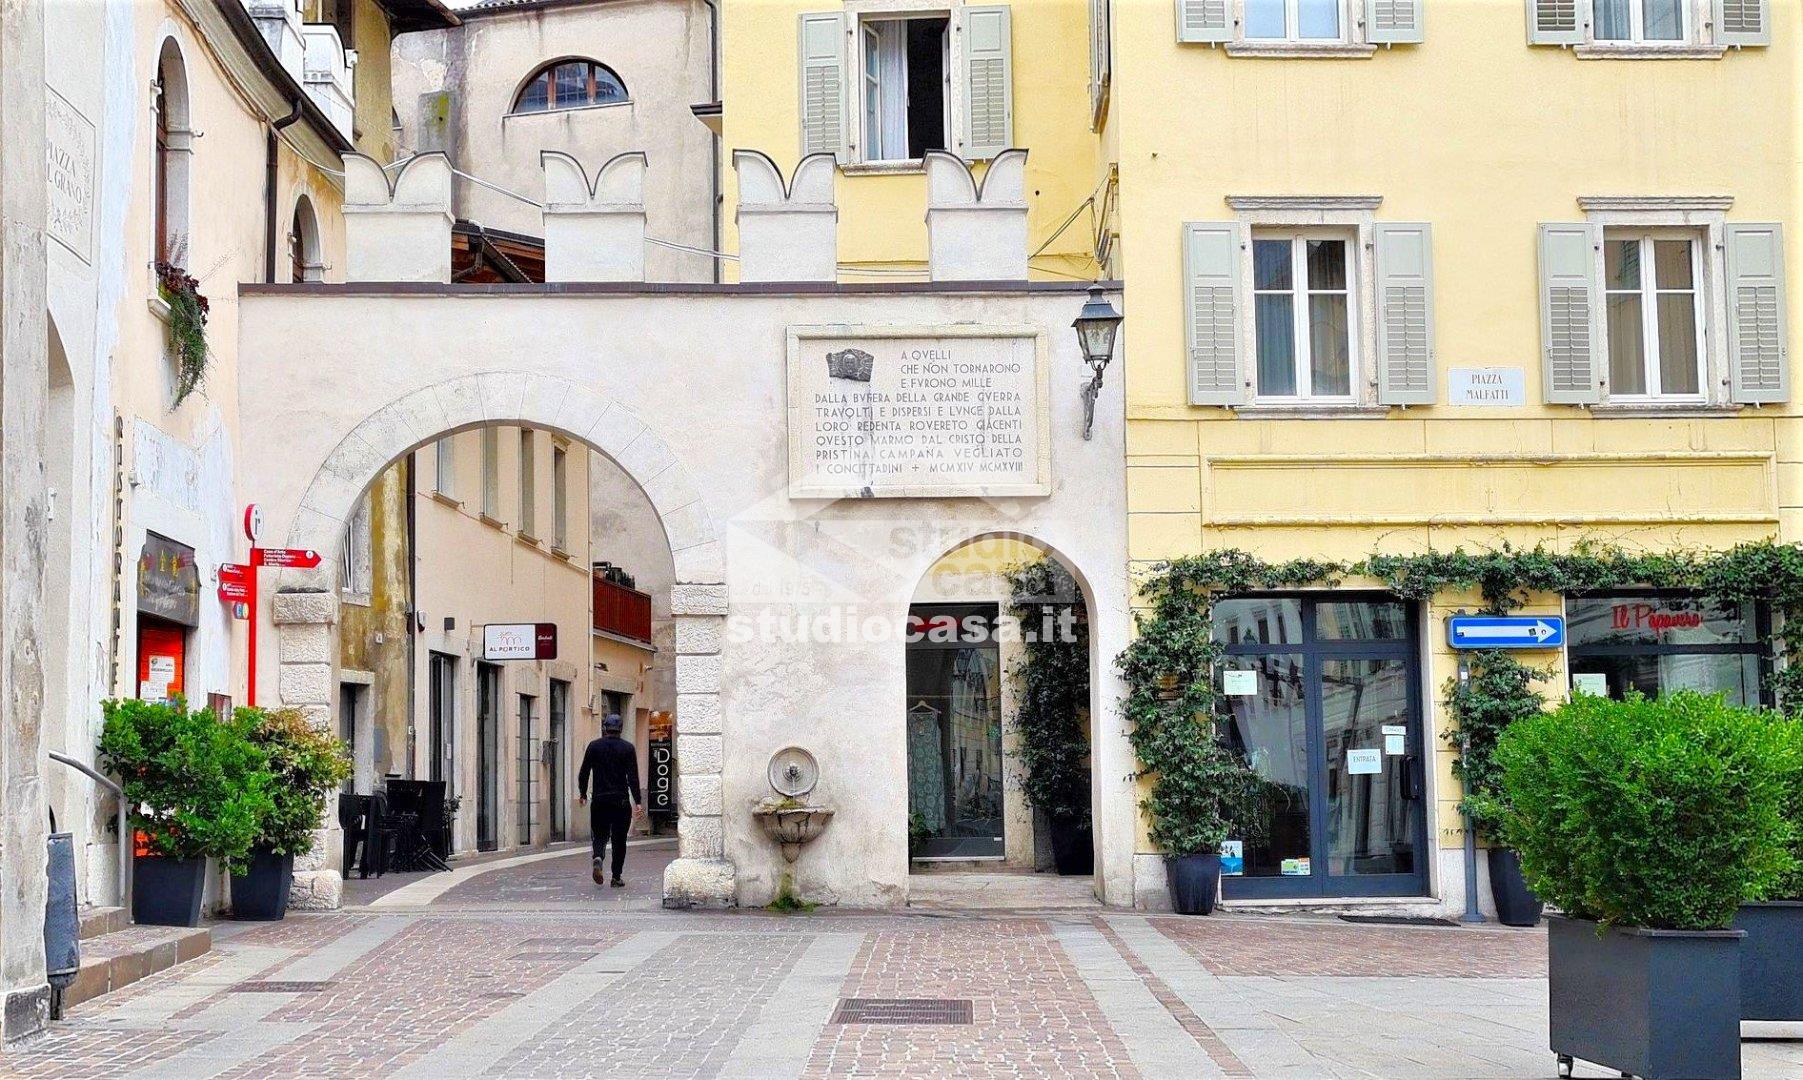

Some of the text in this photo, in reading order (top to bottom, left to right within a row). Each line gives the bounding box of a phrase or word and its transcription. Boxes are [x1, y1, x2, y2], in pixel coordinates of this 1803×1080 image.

[900, 350, 951, 361] A QVELLI
[900, 363, 1021, 375] CHE NON TORNARONO
[900, 377, 992, 388] E FVRONO MILLE
[1471, 374, 1503, 384] PIAZZA
[814, 391, 1021, 404] DALLA BVFERA DELLA GRANDE GVERRA
[1466, 389, 1509, 399] MALFATTI
[815, 405, 1021, 418] TRAVOLTI E DISPERSI E LVNGE DALLA
[815, 419, 1022, 432] LORO REDENTA ROVERETO GIACENTI
[815, 434, 1022, 446] QVESTO MARMO DAL CRISTO DELLA
[816, 447, 1023, 460] PRISTINA CAMPANA VEGLIATO
[827, 463, 903, 475] CONCITTADINI
[929, 462, 974, 473] MCMXIV
[979, 461, 1023, 472] MCMXVIII
[1609, 603, 1630, 629] Il
[1353, 755, 1377, 763] ENTRATA
[656, 747, 671, 806] Doge
